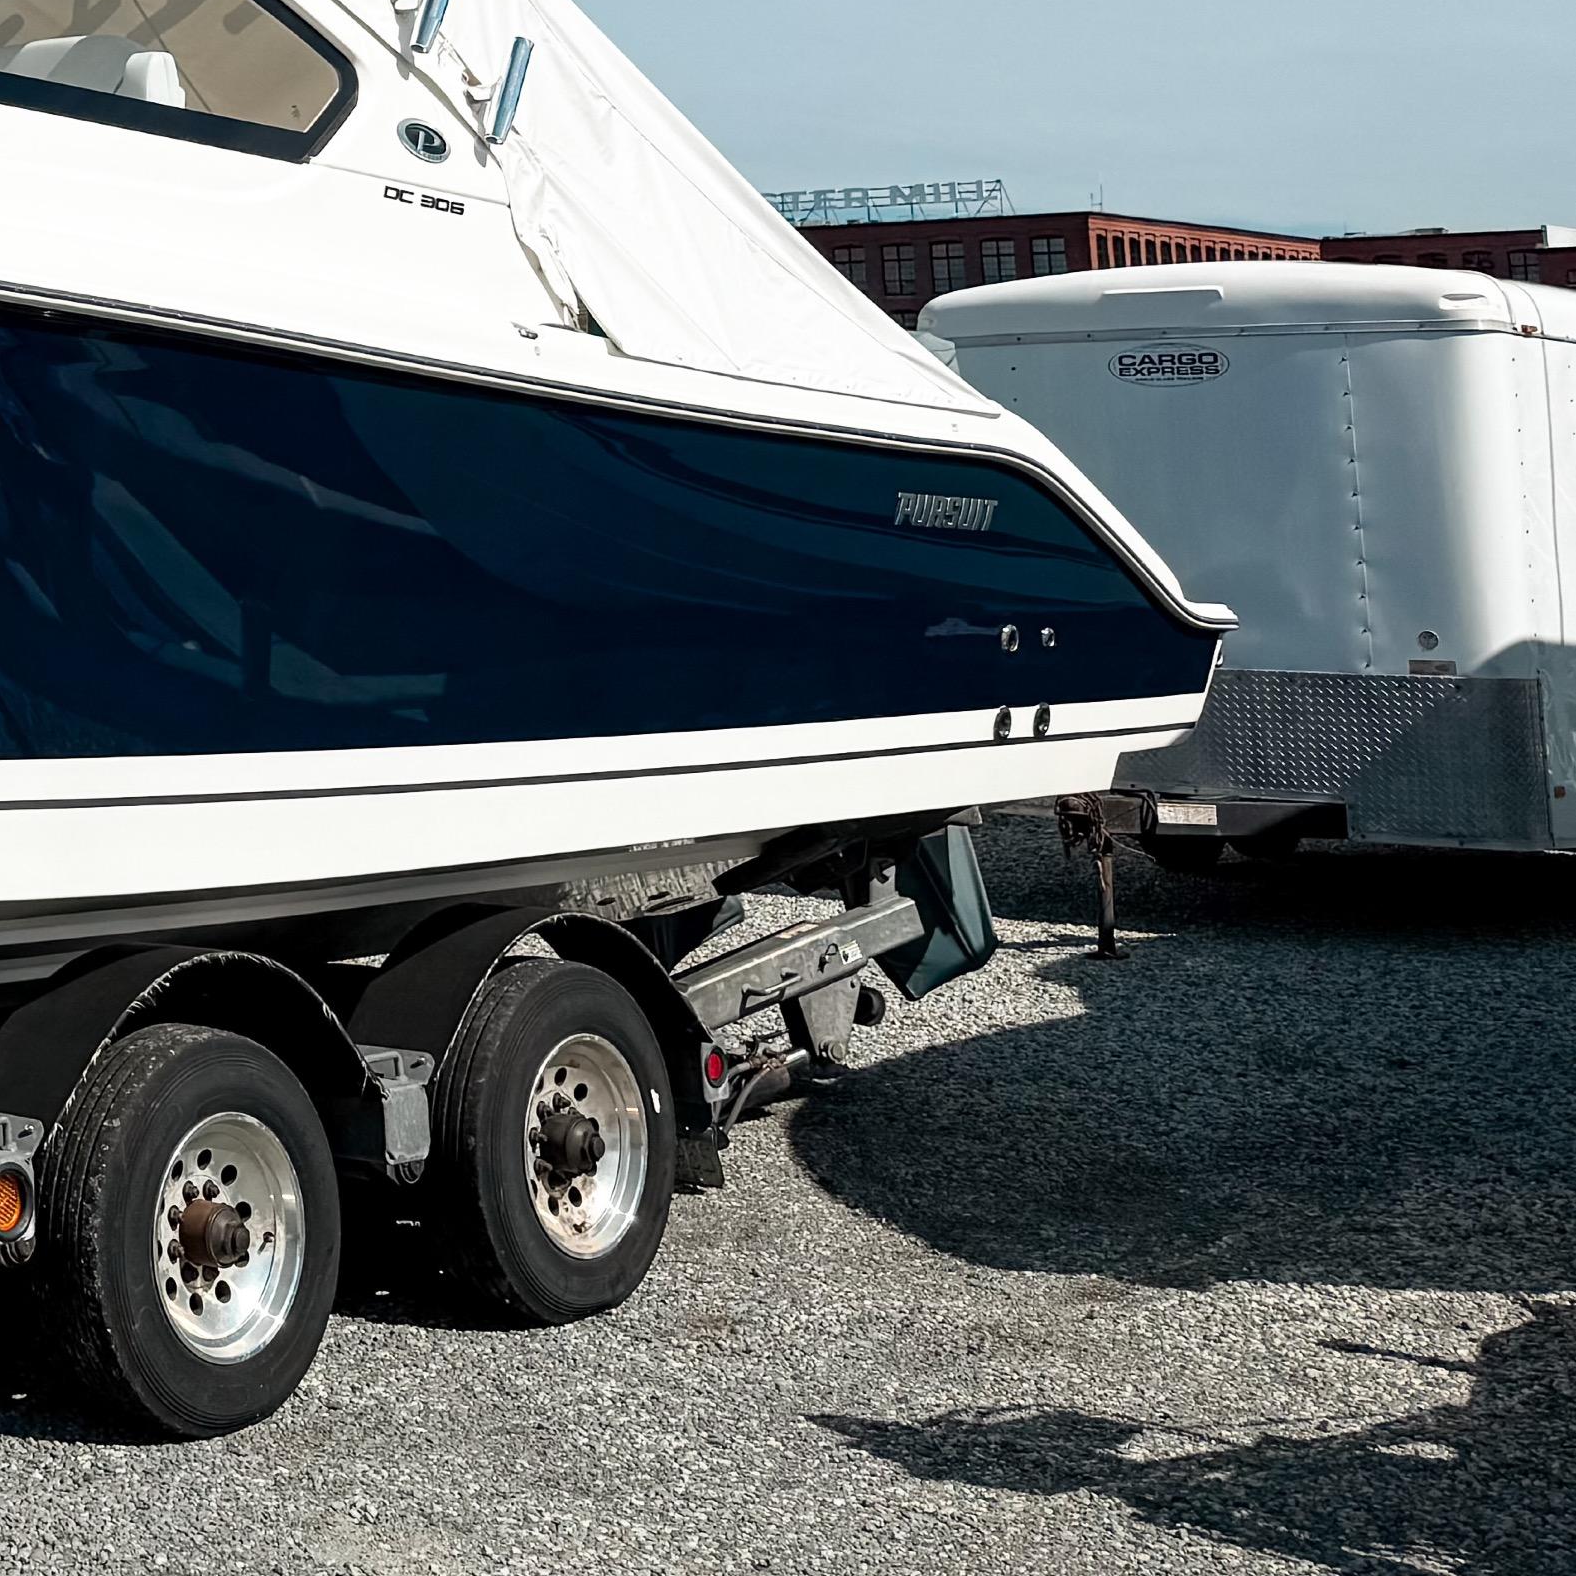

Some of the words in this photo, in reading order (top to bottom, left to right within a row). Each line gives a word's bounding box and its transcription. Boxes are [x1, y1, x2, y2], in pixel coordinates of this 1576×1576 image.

[383, 185, 415, 205] DC
[420, 194, 465, 216] 306
[889, 179, 1000, 206] MILL
[1117, 352, 1219, 367] CARGO
[1118, 365, 1220, 377] EXPRESS
[894, 491, 999, 531] PURSUIT
